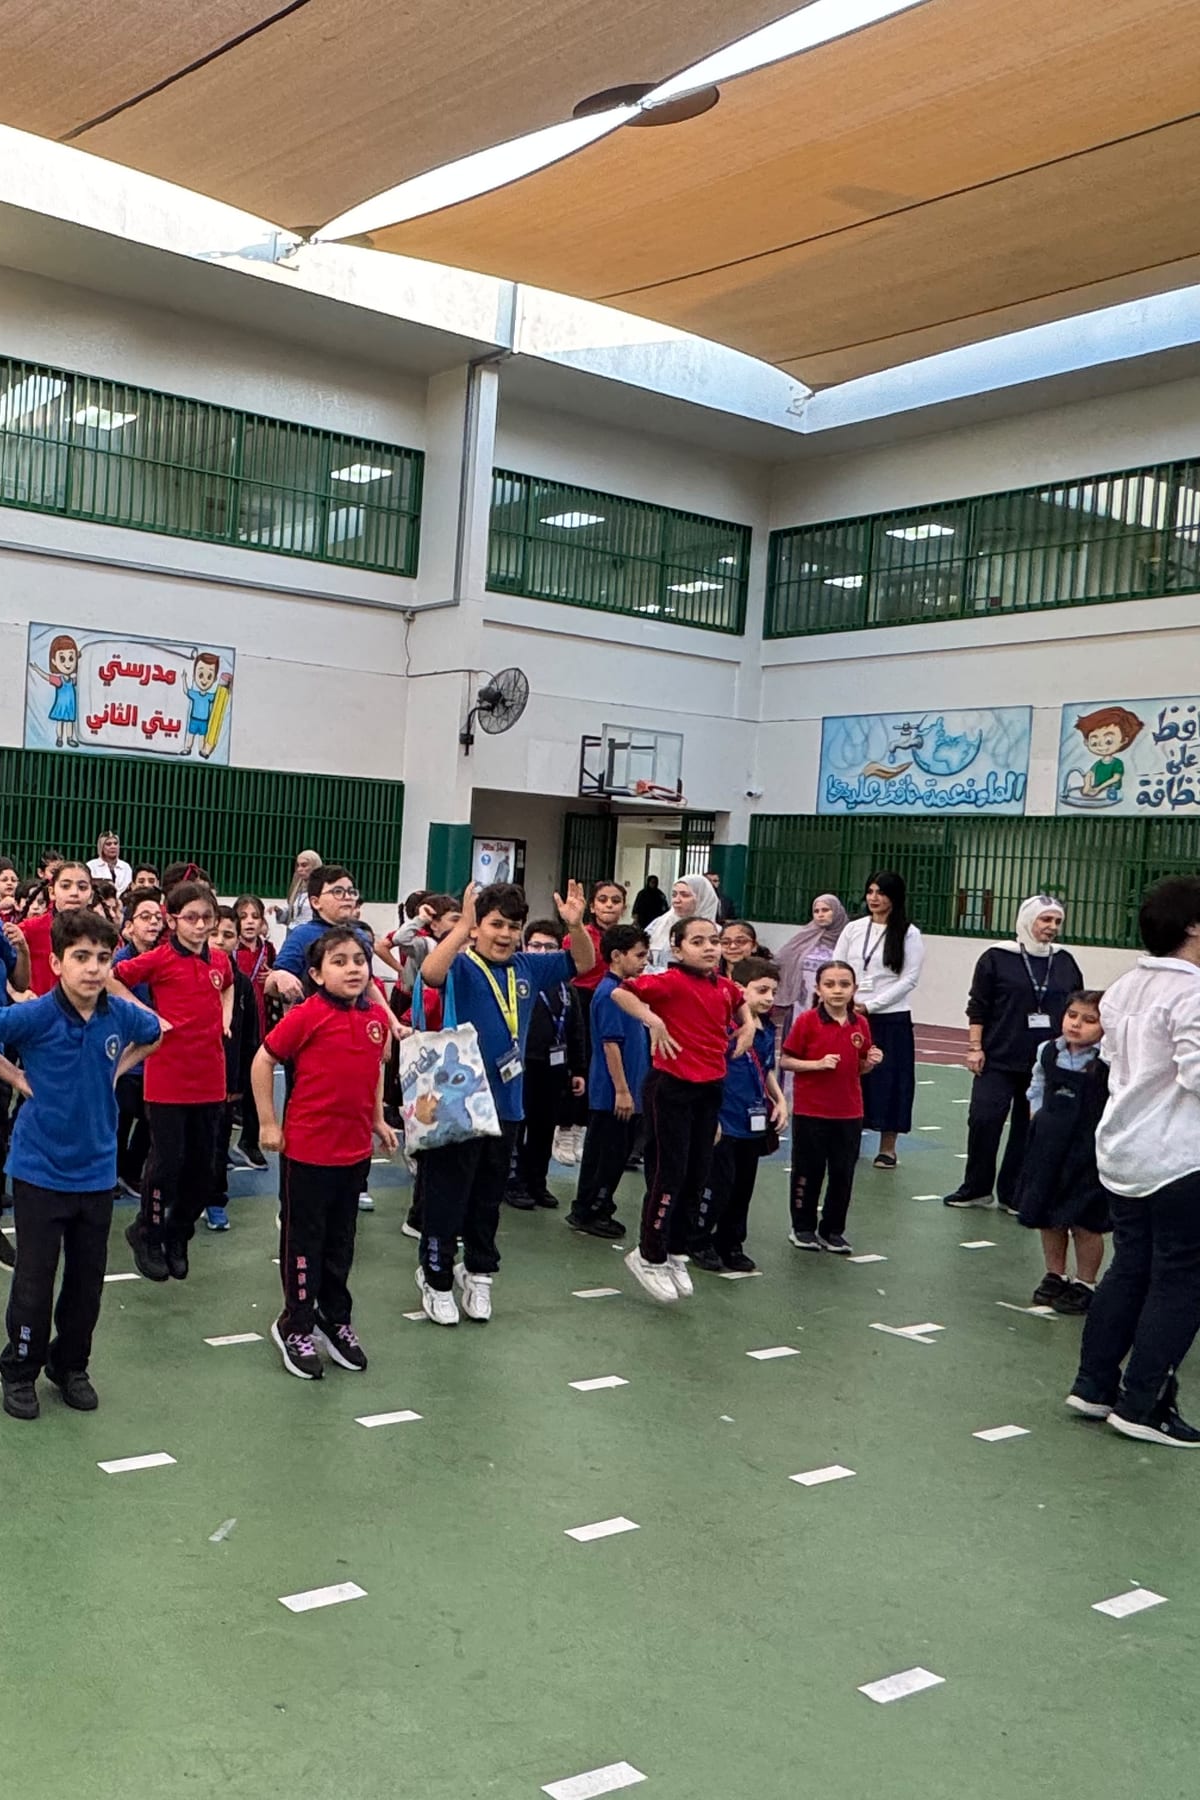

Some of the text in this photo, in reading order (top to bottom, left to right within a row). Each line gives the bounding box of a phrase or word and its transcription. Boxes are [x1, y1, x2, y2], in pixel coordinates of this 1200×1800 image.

[98, 654, 177, 686] مدرستي
[85, 703, 182, 740] بيتي الثاني
